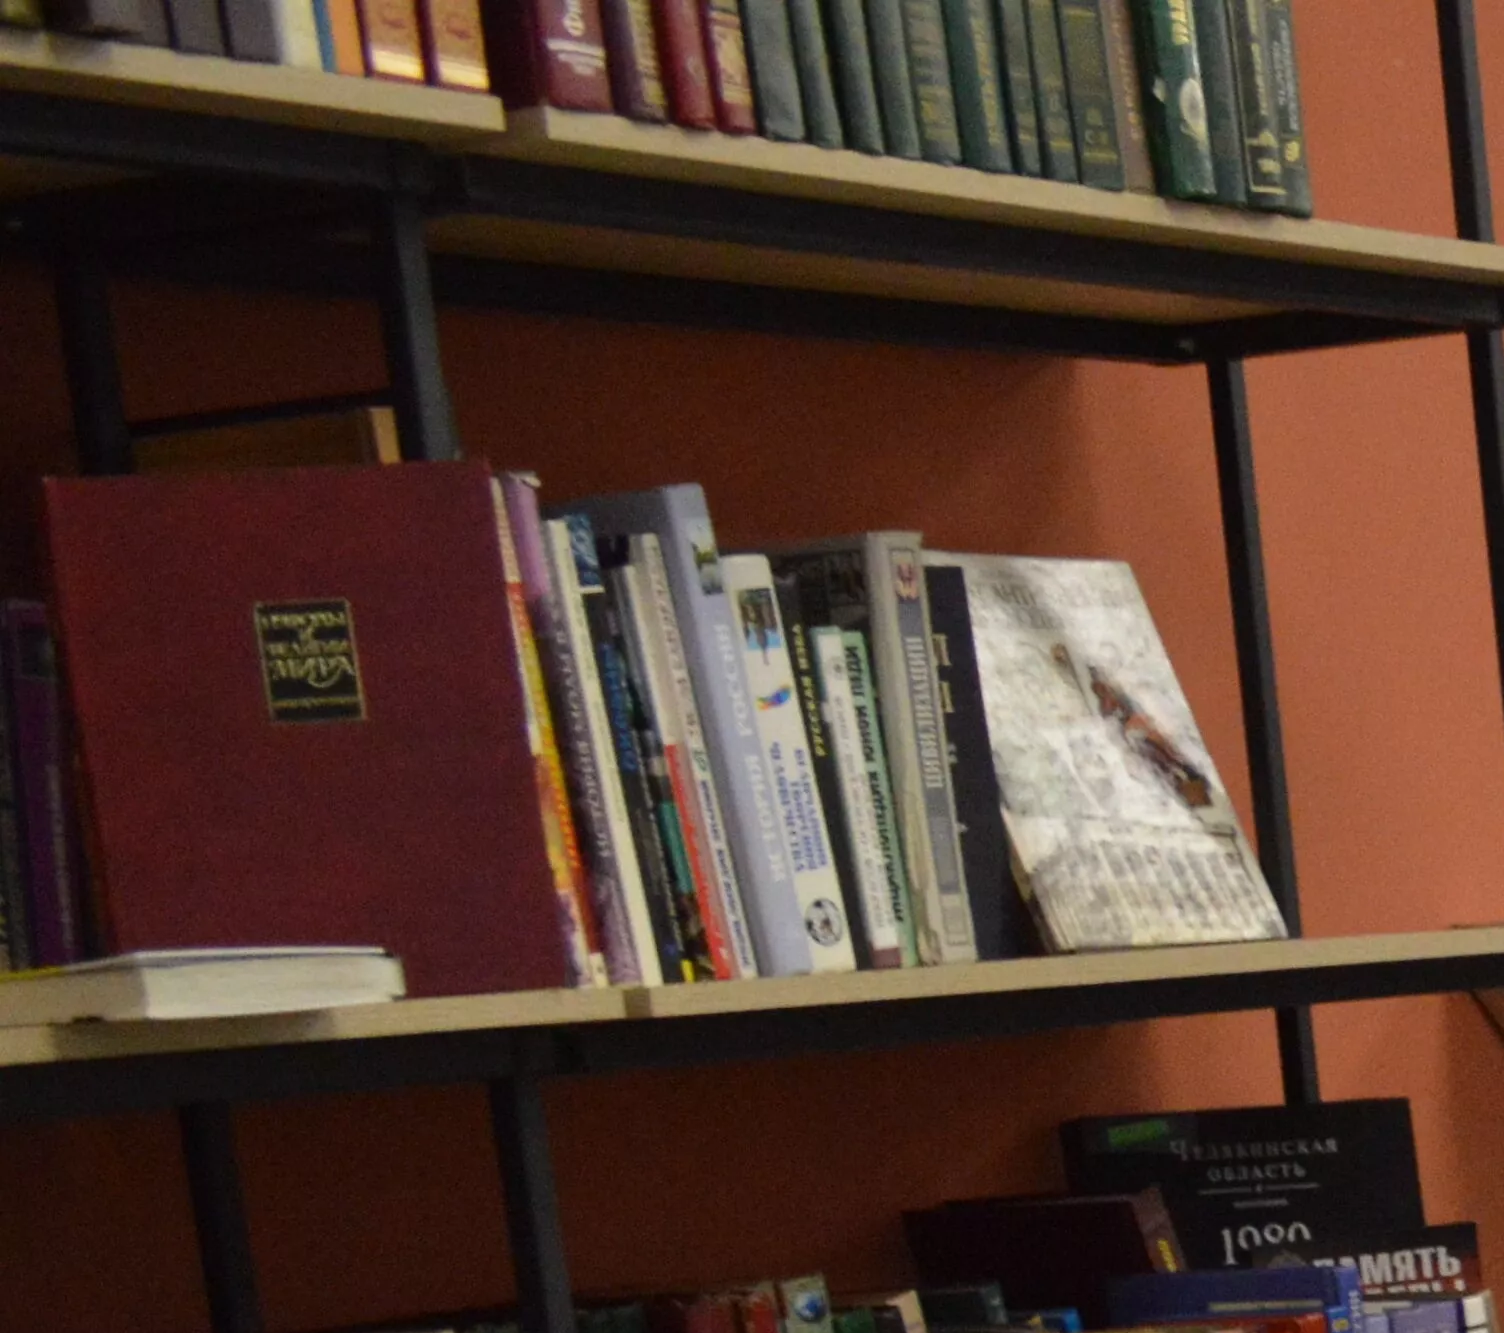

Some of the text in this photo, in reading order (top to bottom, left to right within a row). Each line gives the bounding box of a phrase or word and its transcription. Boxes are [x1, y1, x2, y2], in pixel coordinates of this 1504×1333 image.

[799, 676, 826, 756] РУССКАЯ
[712, 623, 789, 883] ИСТОРИЯ РОССИИ
[1207, 1162, 1306, 1182] ОБЛАСТЬ
[1313, 1246, 1462, 1286] МЯТЬ
